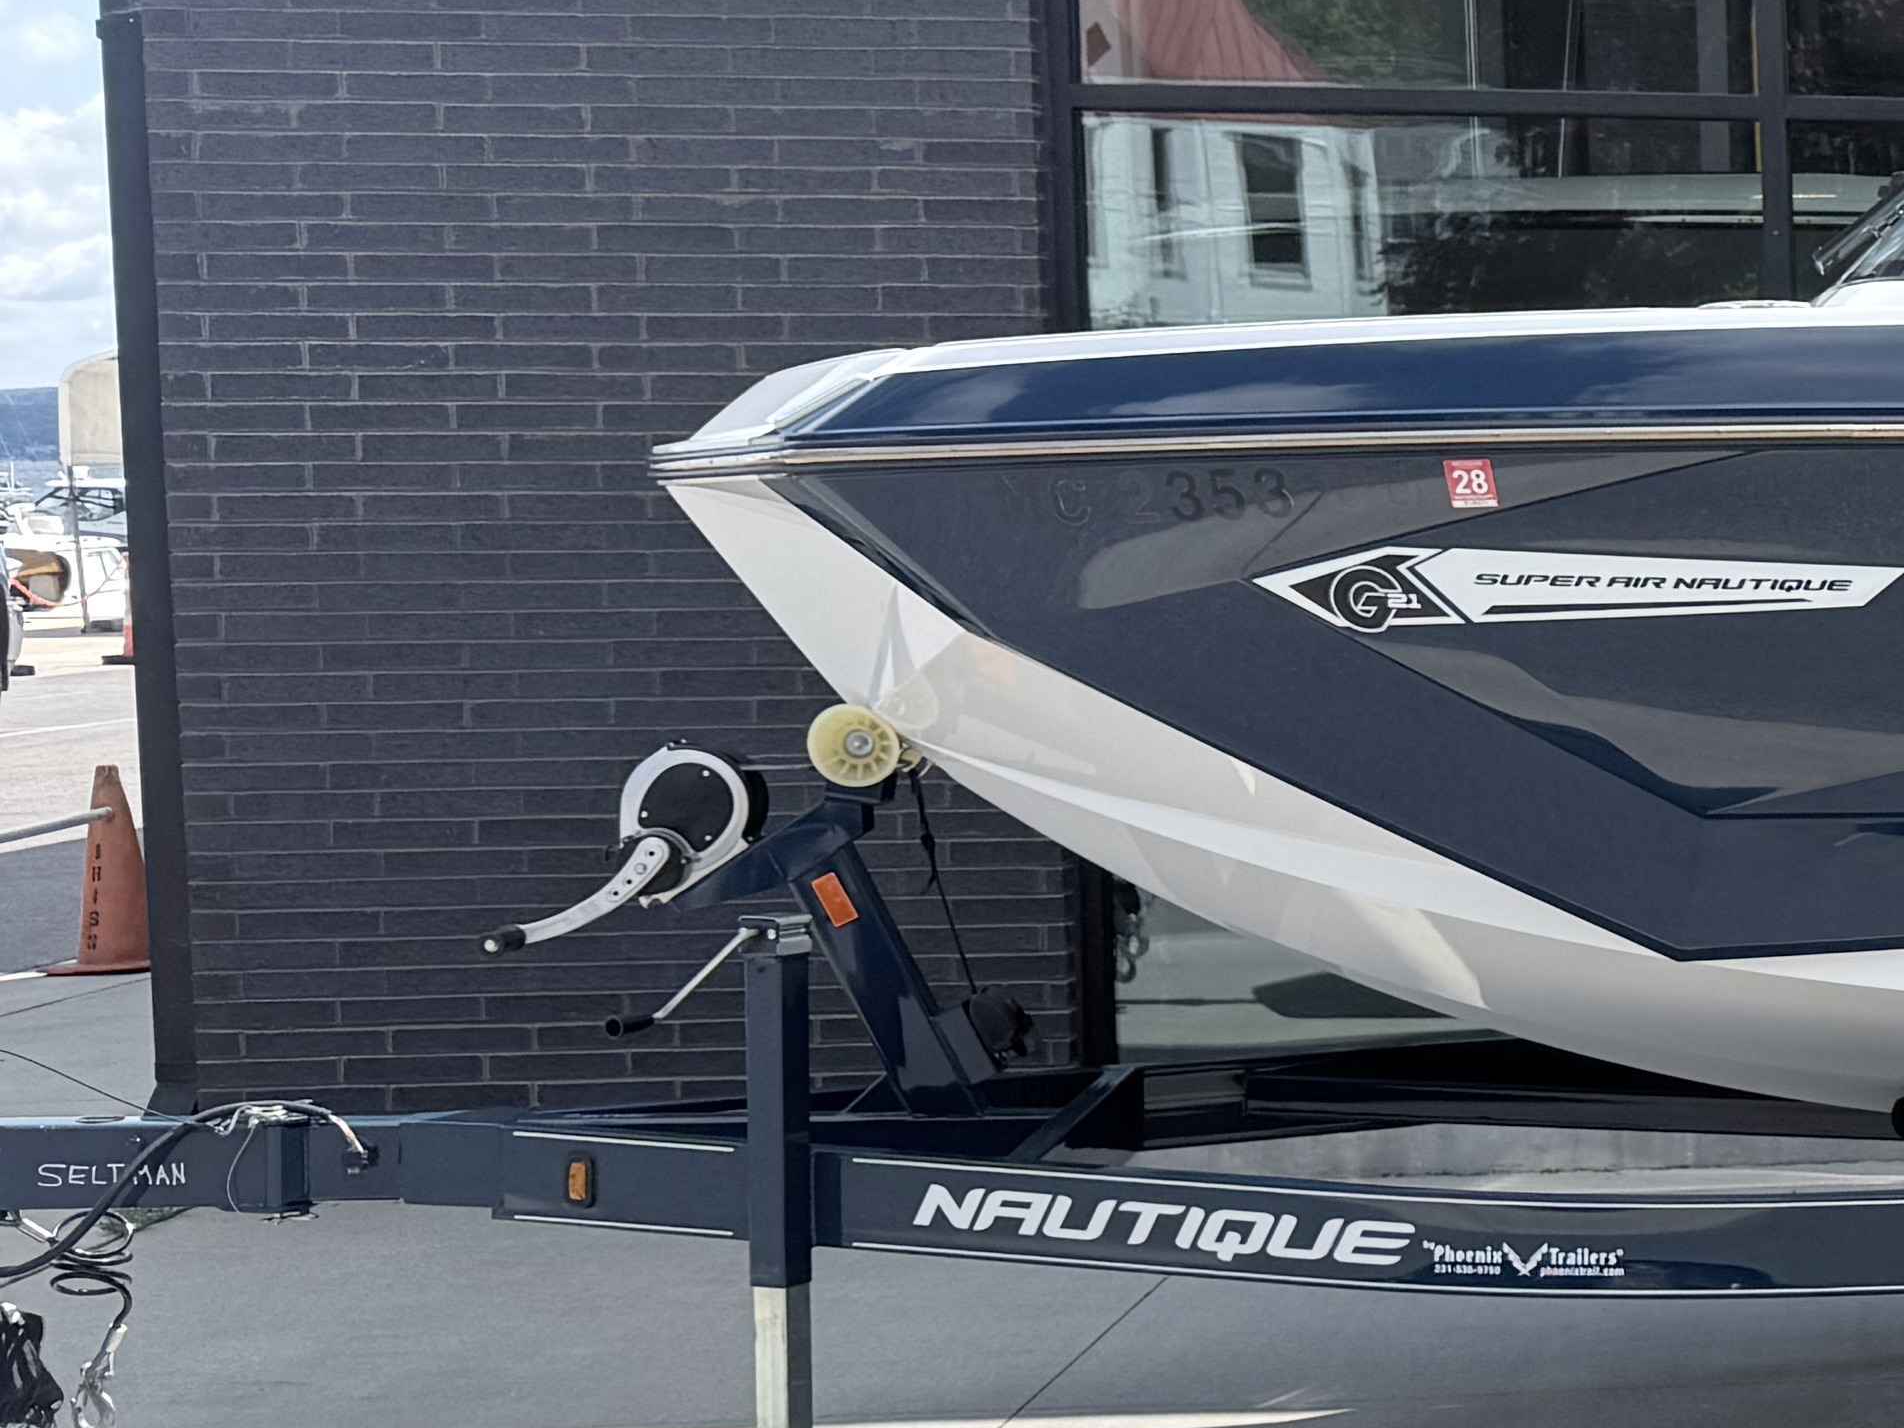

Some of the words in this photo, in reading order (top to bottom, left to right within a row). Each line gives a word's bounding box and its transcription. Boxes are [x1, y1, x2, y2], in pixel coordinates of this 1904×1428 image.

[1452, 469, 1488, 494] 28
[1474, 573, 1601, 588] SUPER
[1606, 576, 1667, 590] AIR
[1673, 577, 1853, 593] NAUTIQUE
[912, 1183, 1416, 1263] NAUTIQUE
[1434, 1245, 1502, 1263] Phoenix
[1549, 1247, 1617, 1265] Trailers
